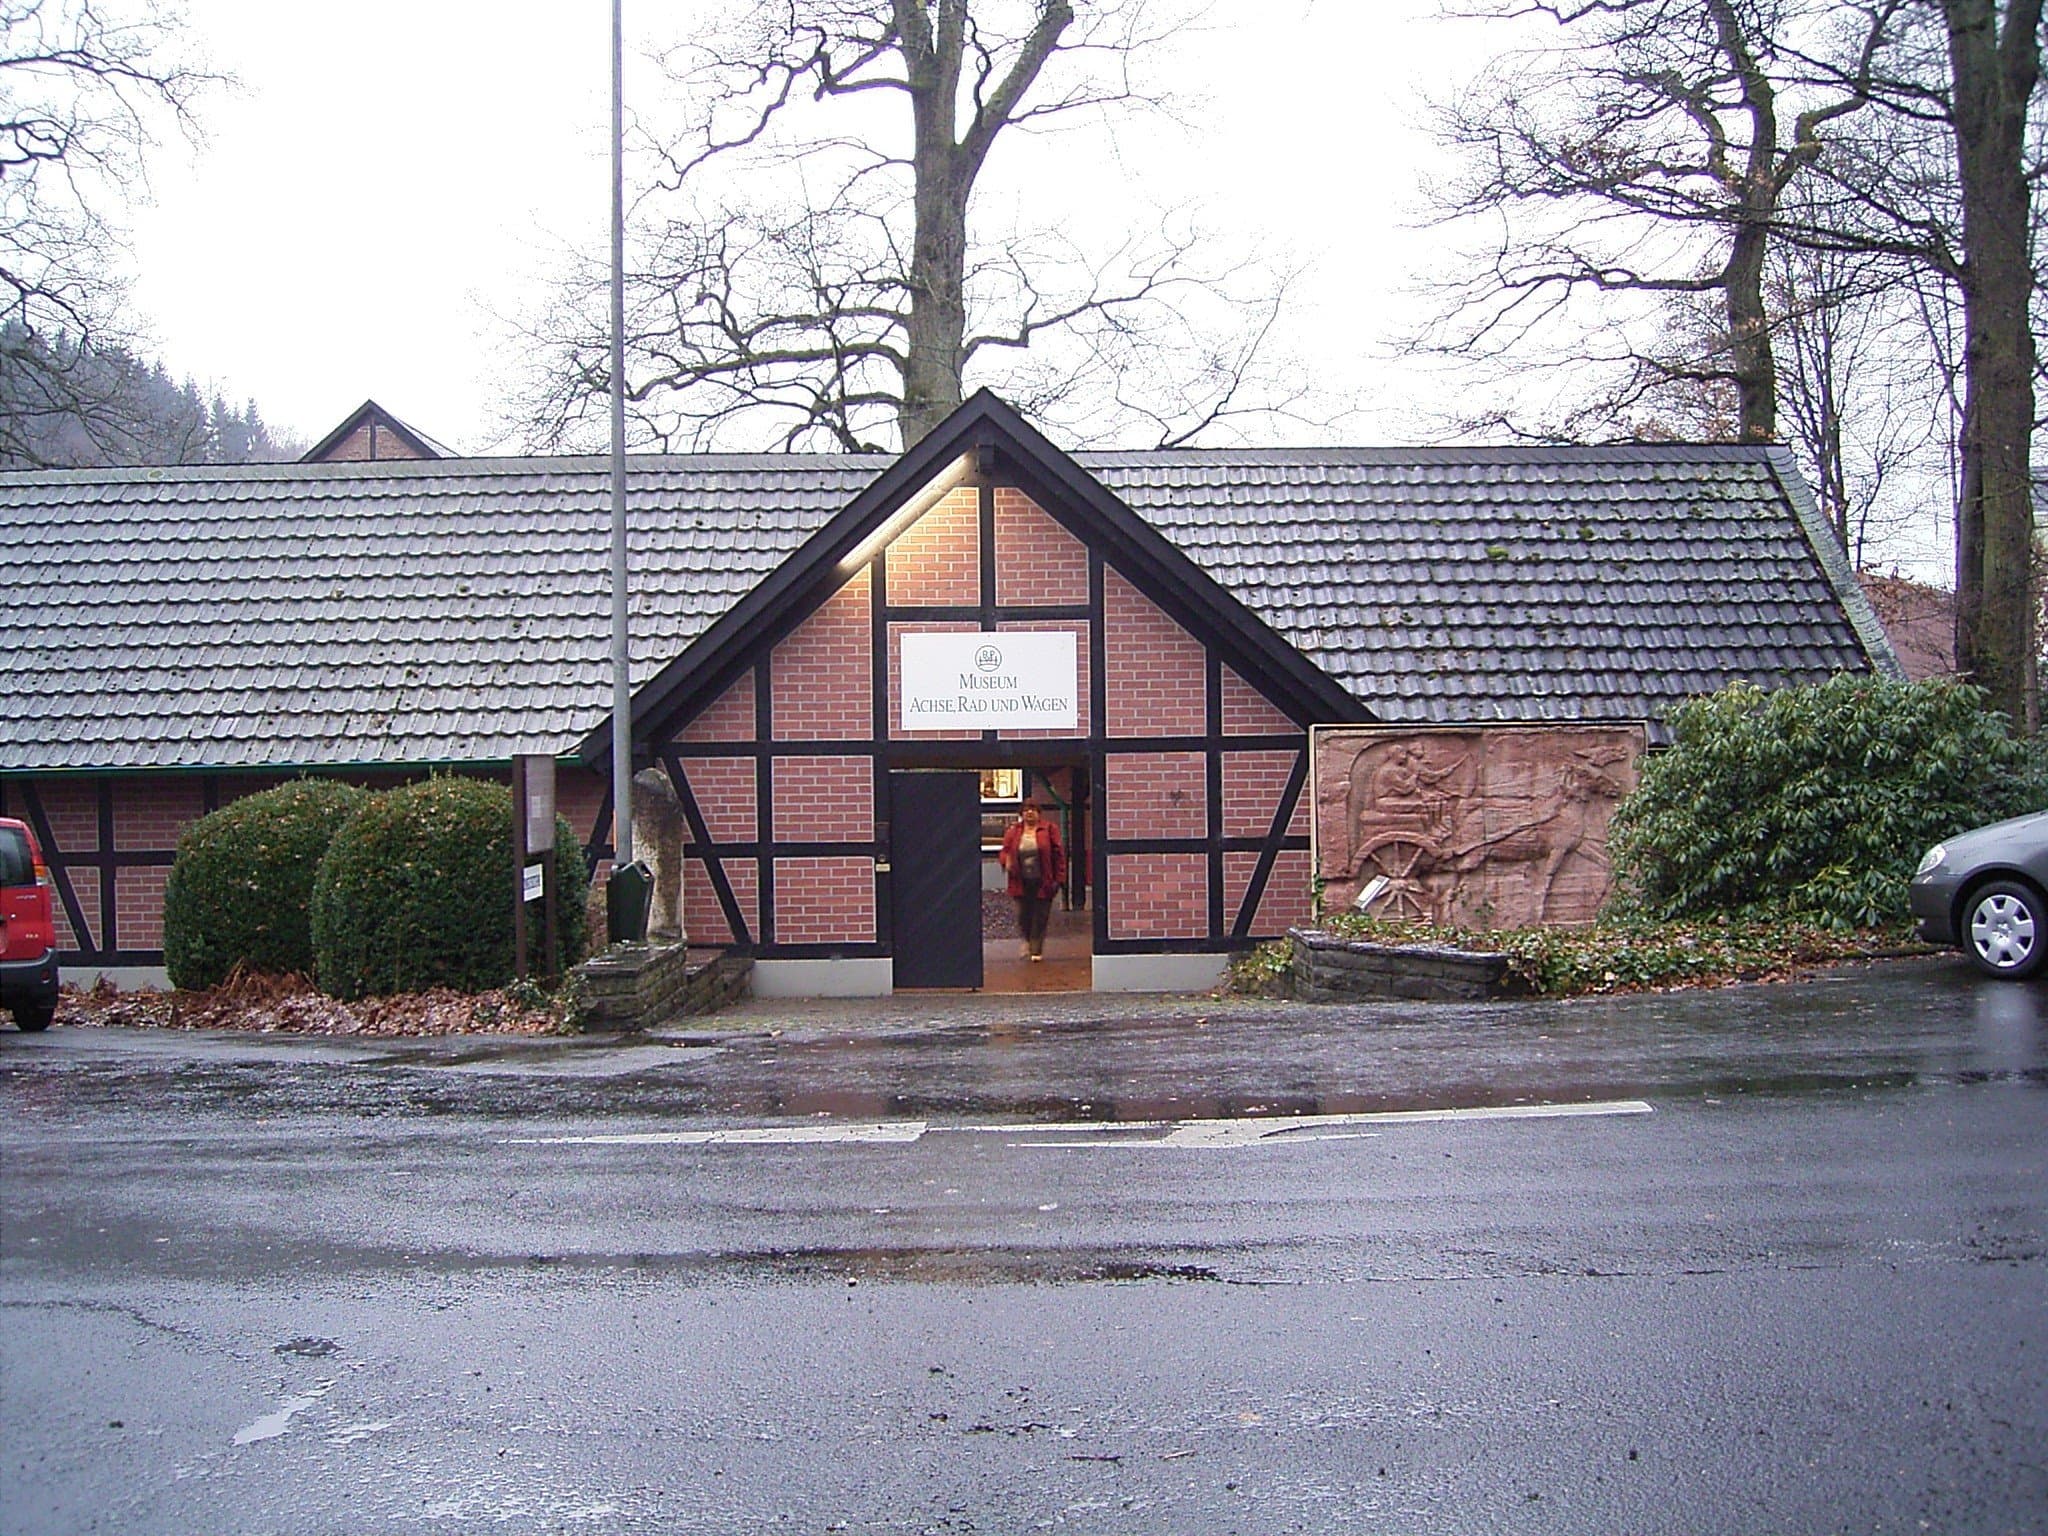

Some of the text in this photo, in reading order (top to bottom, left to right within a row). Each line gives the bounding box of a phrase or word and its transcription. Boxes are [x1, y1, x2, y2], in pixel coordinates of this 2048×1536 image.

[959, 673, 1018, 690] MUSEUM
[909, 695, 1068, 713] ACHSE, RAD UND WAGEN
